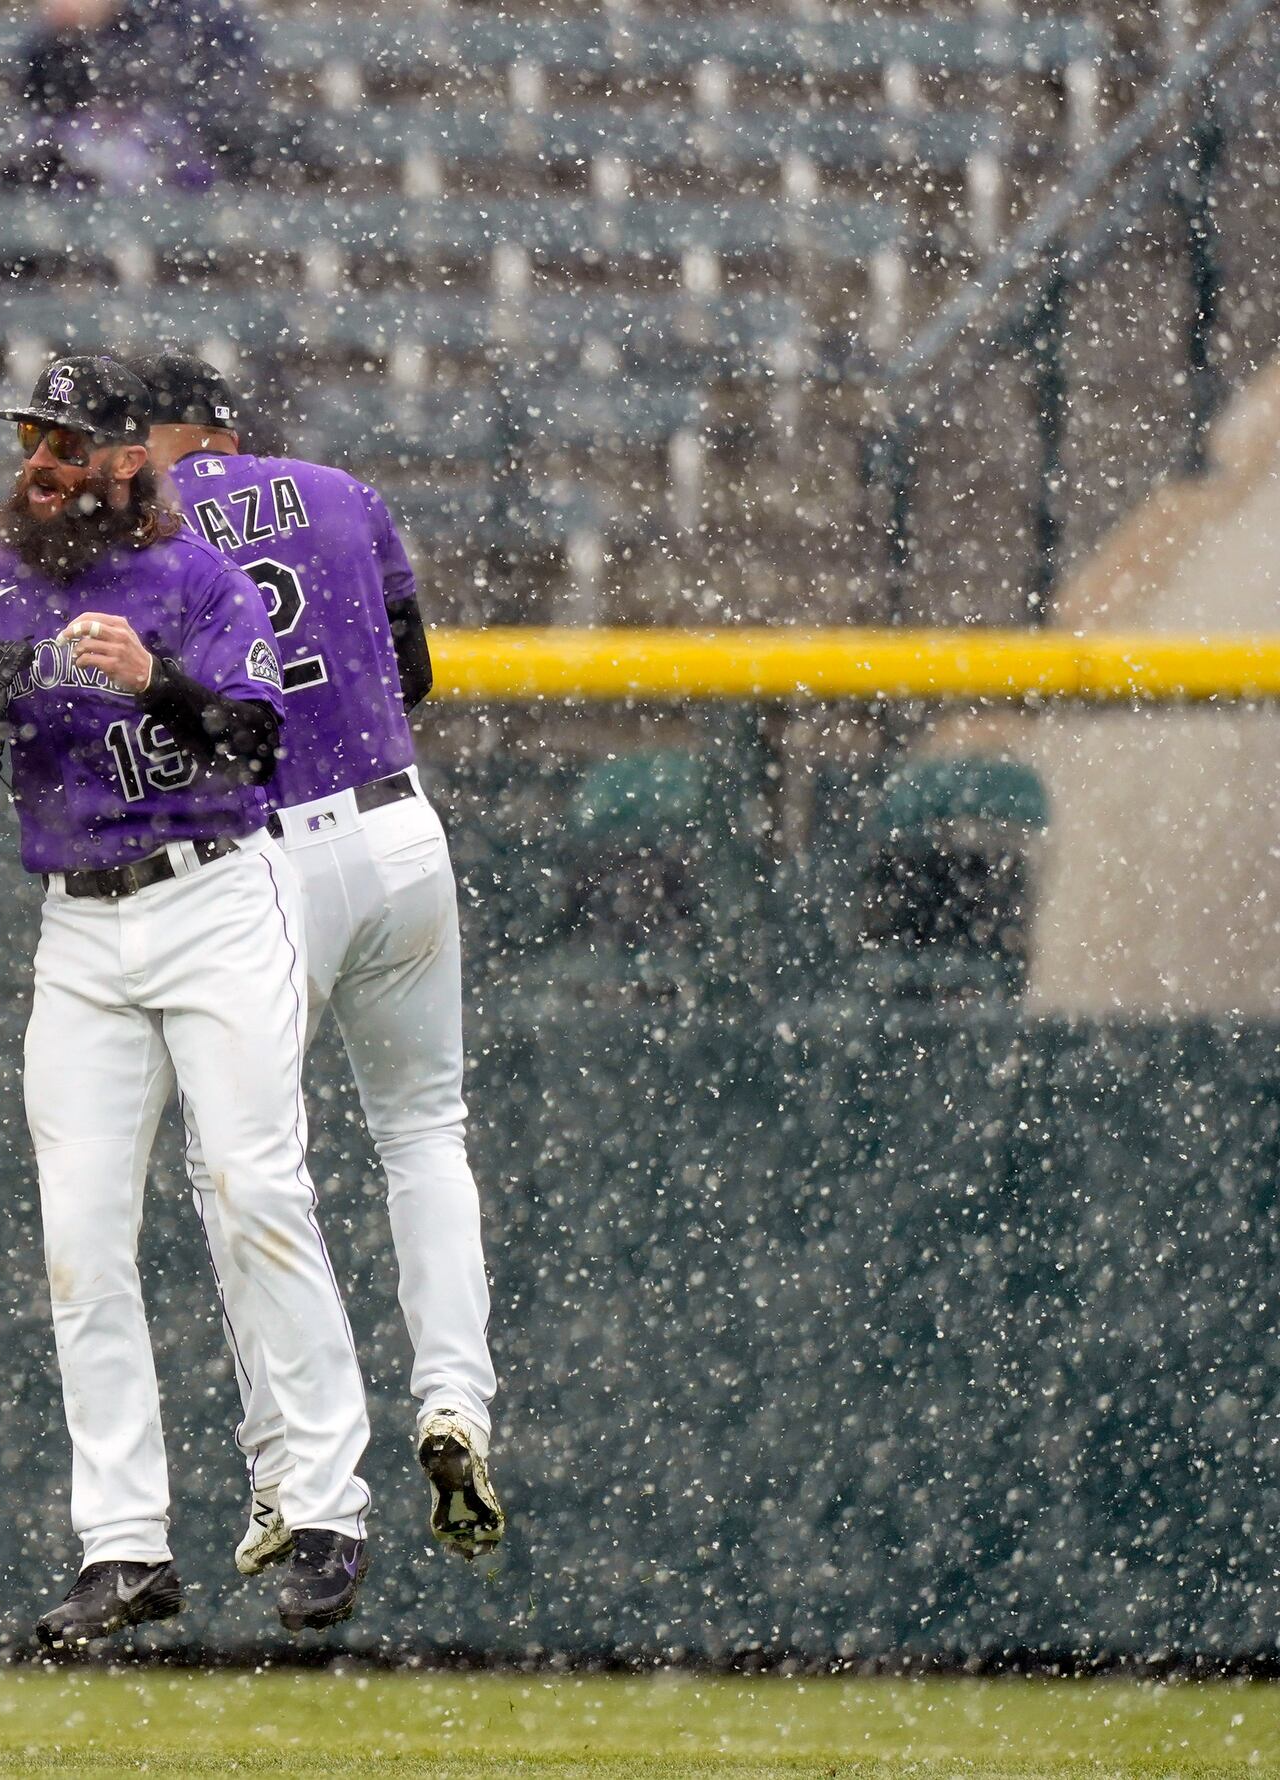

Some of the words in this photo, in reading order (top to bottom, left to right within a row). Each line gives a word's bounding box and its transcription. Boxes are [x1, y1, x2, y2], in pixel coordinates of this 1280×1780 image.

[48, 365, 74, 404] CR
[181, 476, 310, 552] AZA
[104, 714, 198, 803] 19
